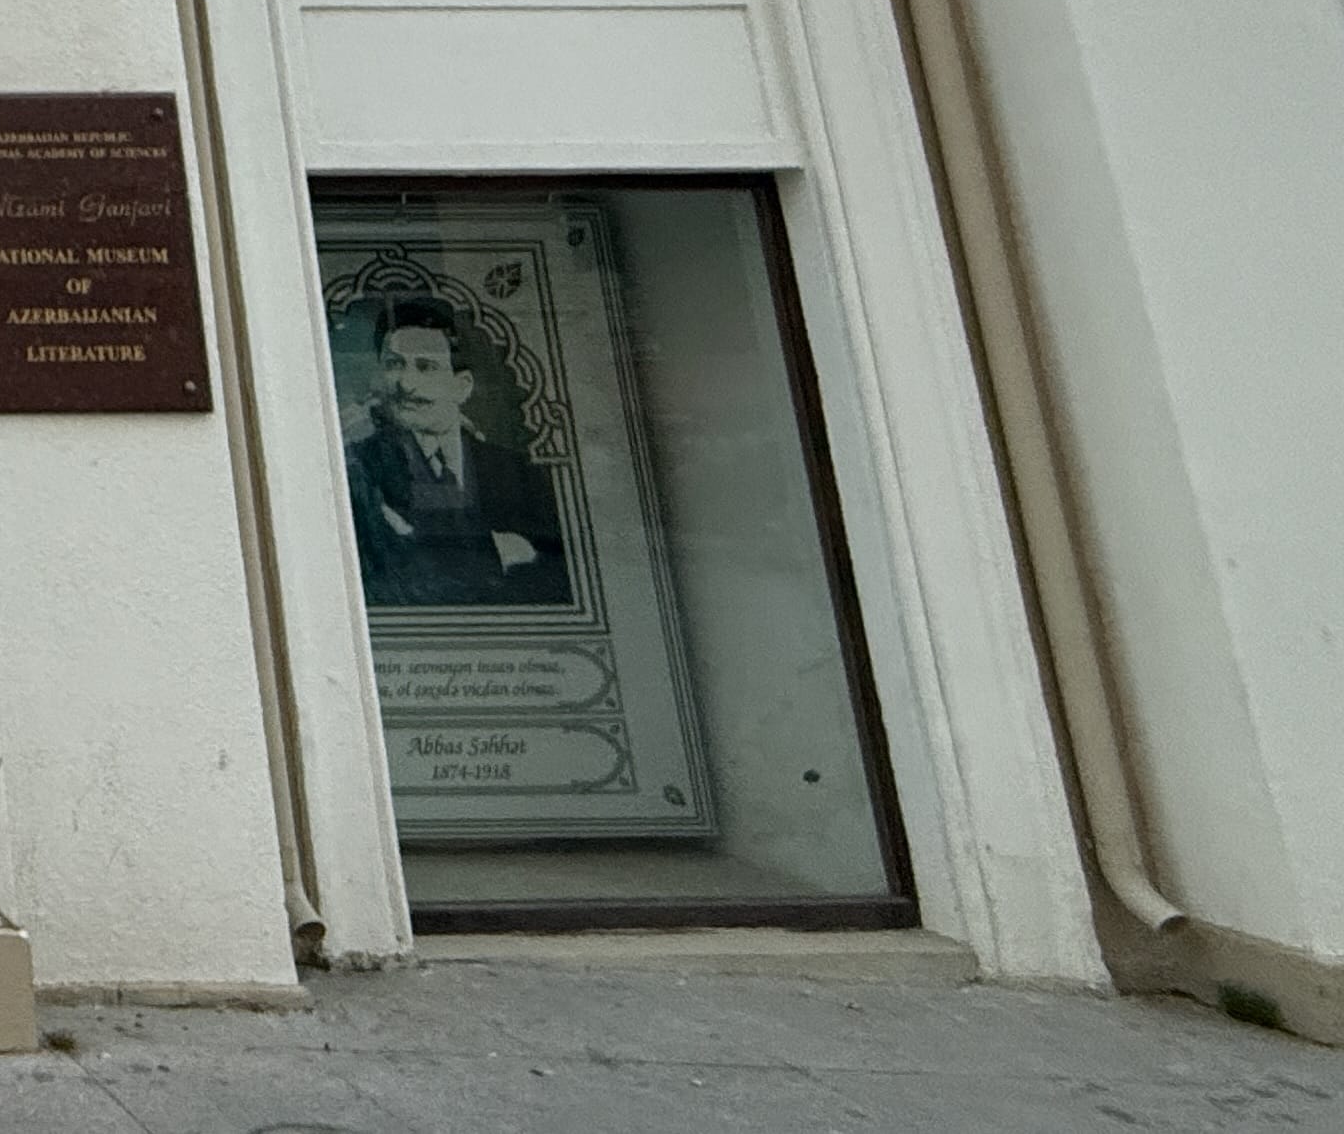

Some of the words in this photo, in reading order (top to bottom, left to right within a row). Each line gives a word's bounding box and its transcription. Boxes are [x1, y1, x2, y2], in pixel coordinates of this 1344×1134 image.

[89, 147, 107, 159] OF
[86, 247, 169, 264] MUSEUM
[65, 277, 92, 295] OF
[5, 306, 158, 324] AZERBAIJANIAN
[26, 344, 147, 363] LITERATURE
[407, 733, 462, 757] Abbas
[431, 763, 512, 780] 1874-1918
